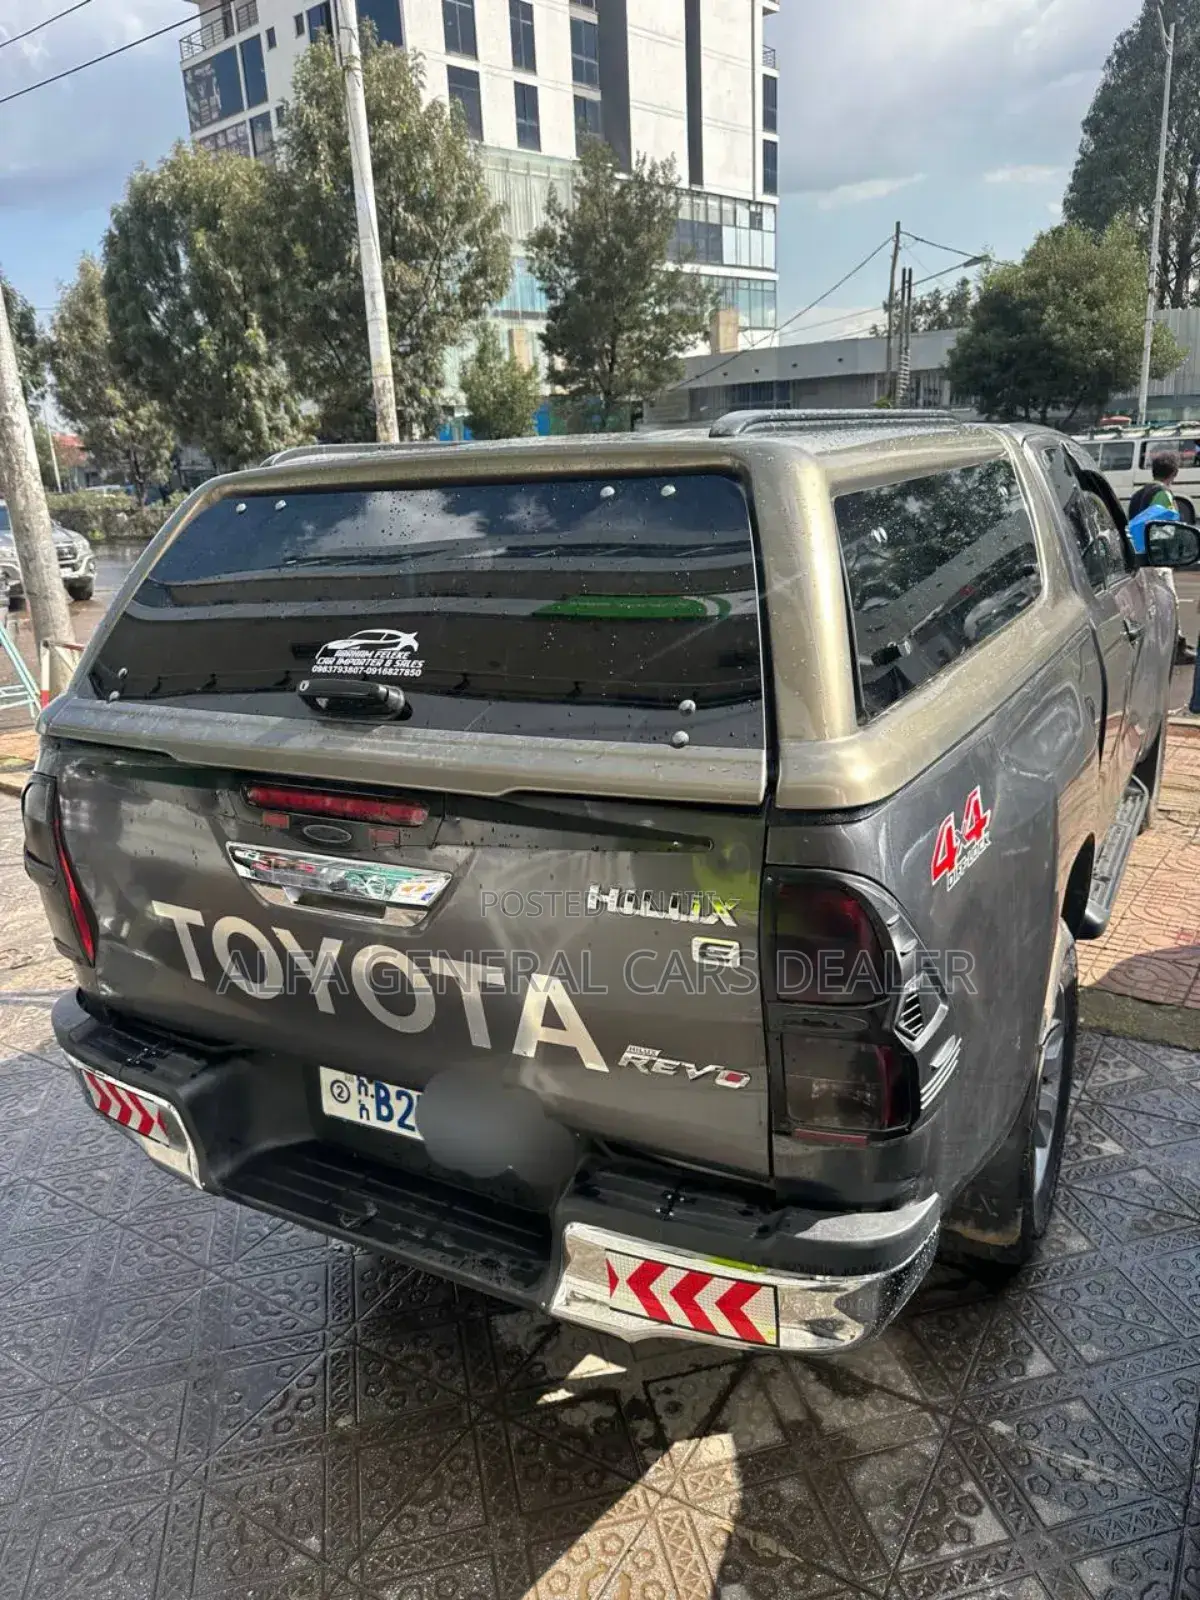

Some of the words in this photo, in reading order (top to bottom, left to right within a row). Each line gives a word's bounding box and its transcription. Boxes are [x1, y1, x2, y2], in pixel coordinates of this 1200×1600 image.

[316, 656, 336, 665] CAR
[335, 657, 385, 667] IMPORTER
[393, 659, 426, 669] SALES
[374, 650, 411, 660] FELEKE
[586, 883, 738, 928] HILUX
[692, 936, 740, 968] G
[152, 900, 609, 1072] TOYOTA
[618, 1052, 751, 1089] REVO
[374, 1080, 420, 1132] B2
